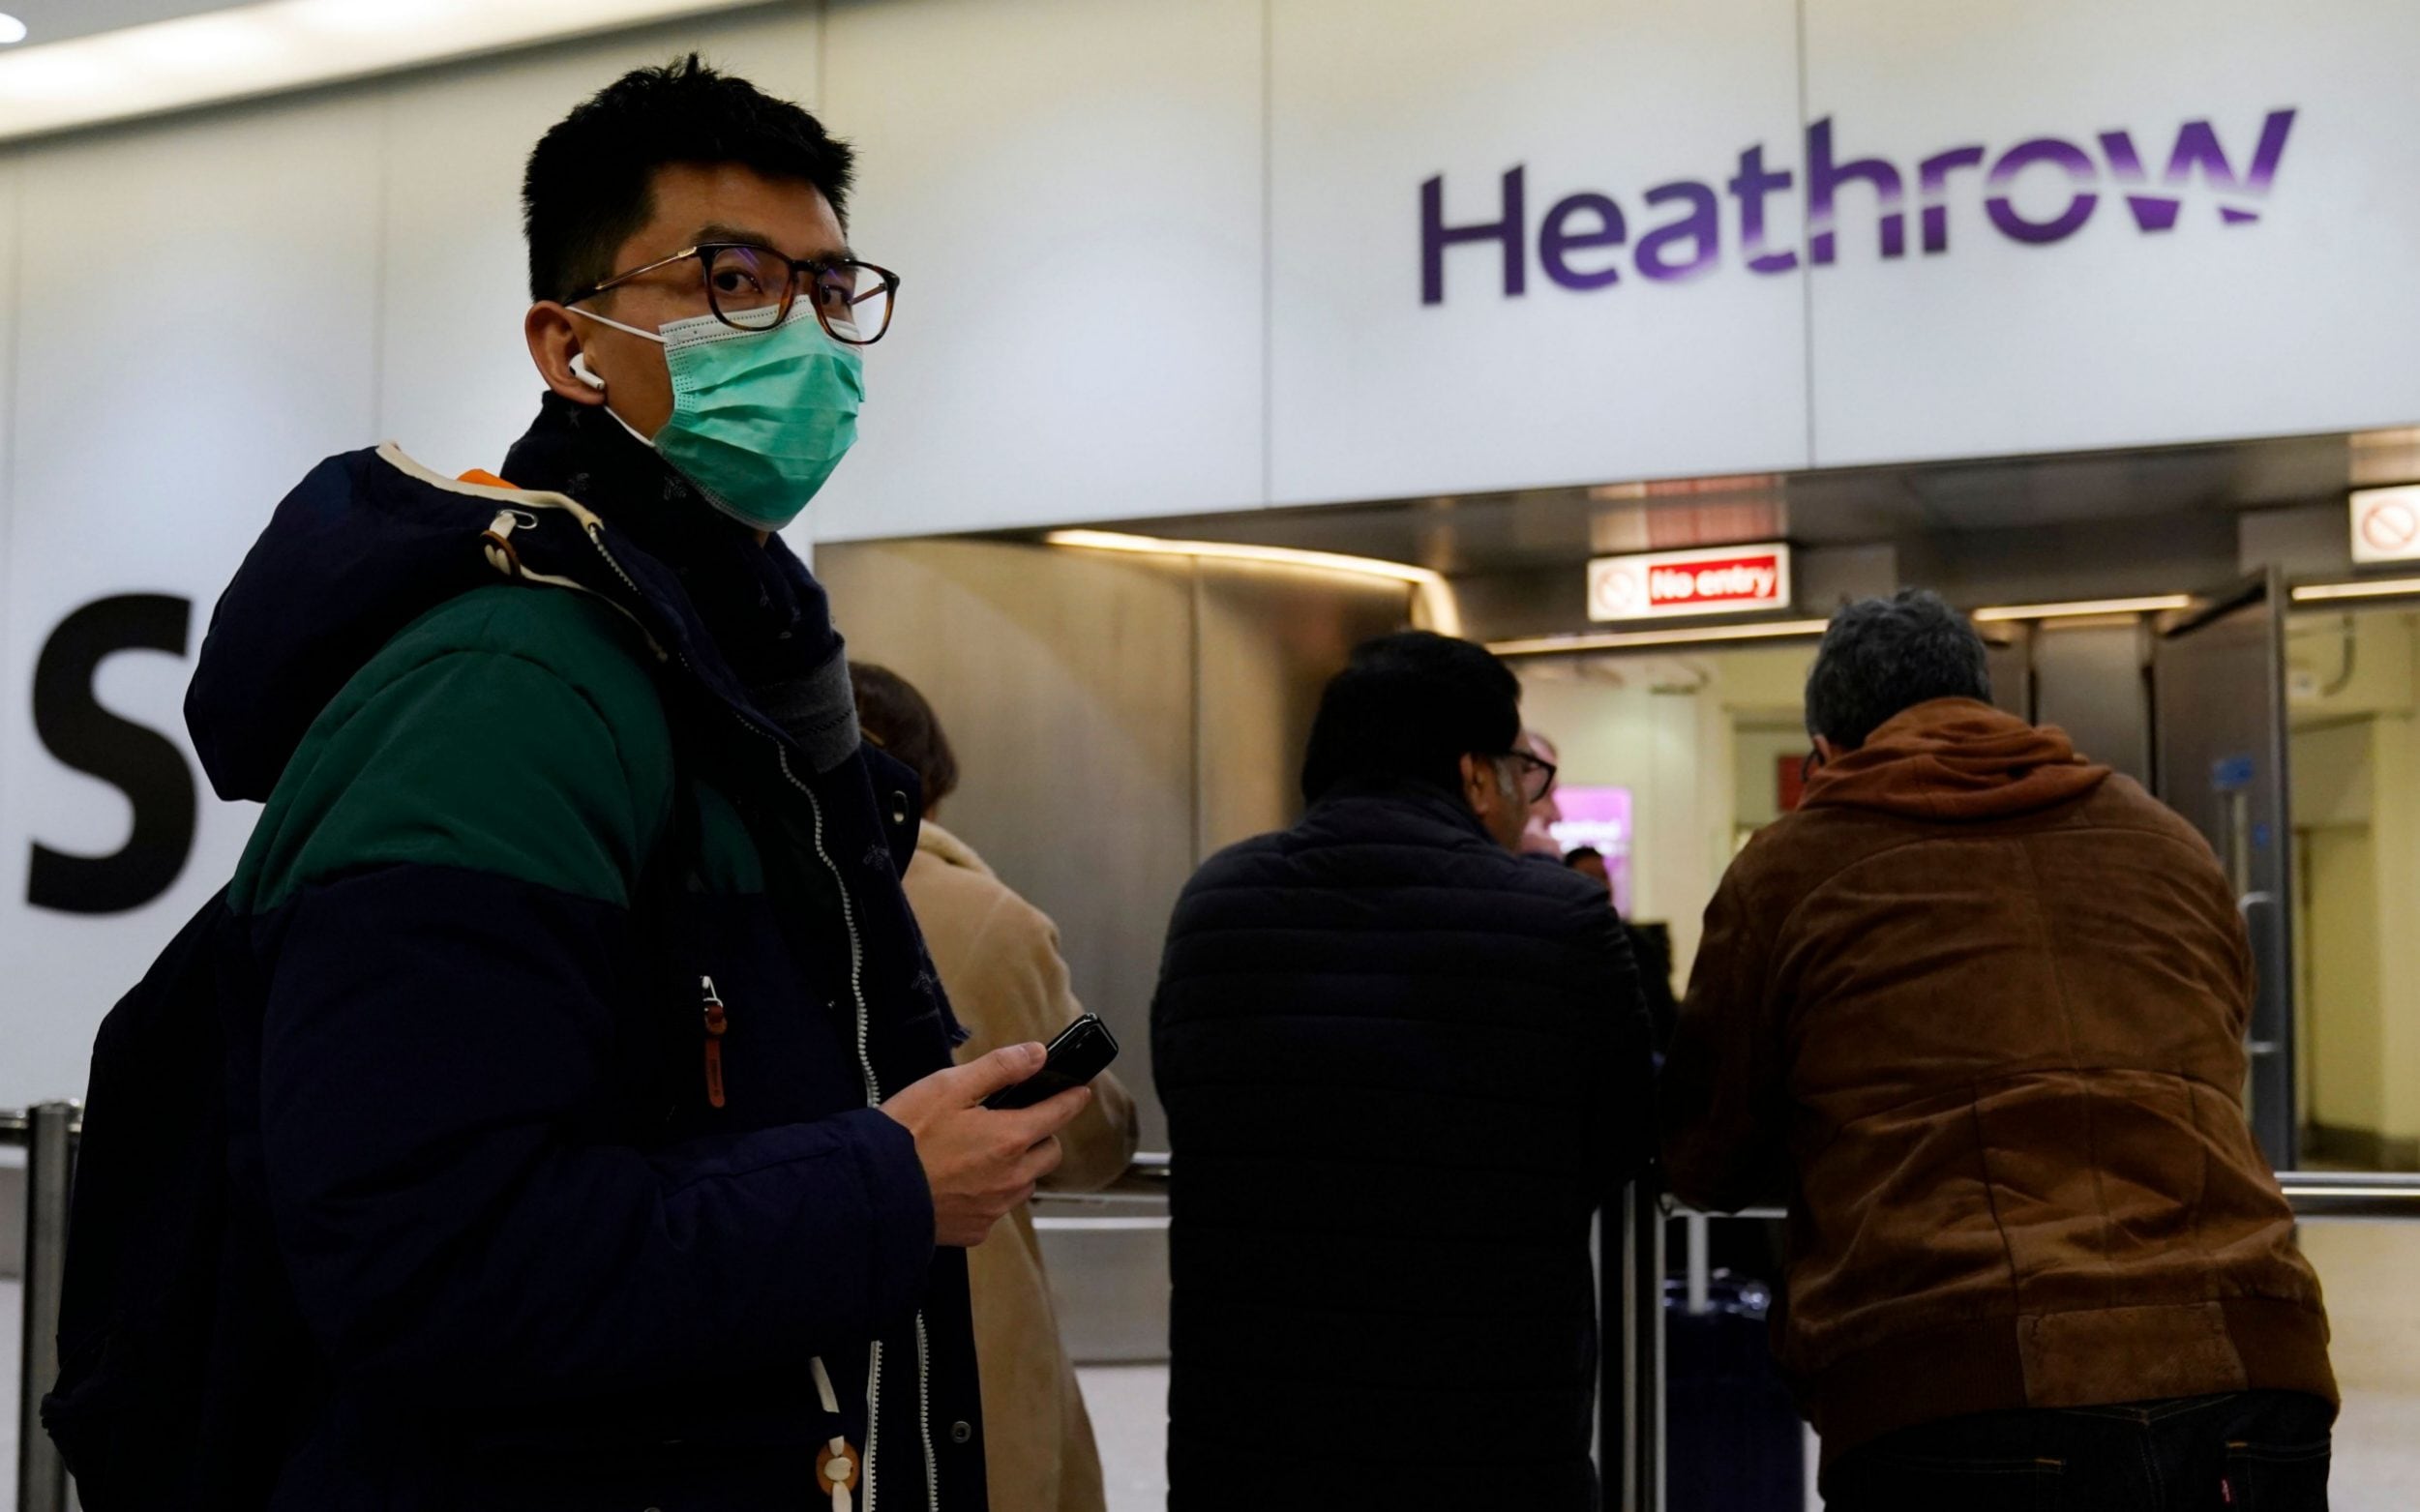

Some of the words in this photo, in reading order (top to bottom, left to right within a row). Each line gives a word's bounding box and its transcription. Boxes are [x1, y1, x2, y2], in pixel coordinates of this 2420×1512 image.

[1420, 107, 2298, 306] Heathrow
[1650, 568, 1694, 600] No
[1695, 563, 1776, 598] entry
[26, 592, 198, 915] S
